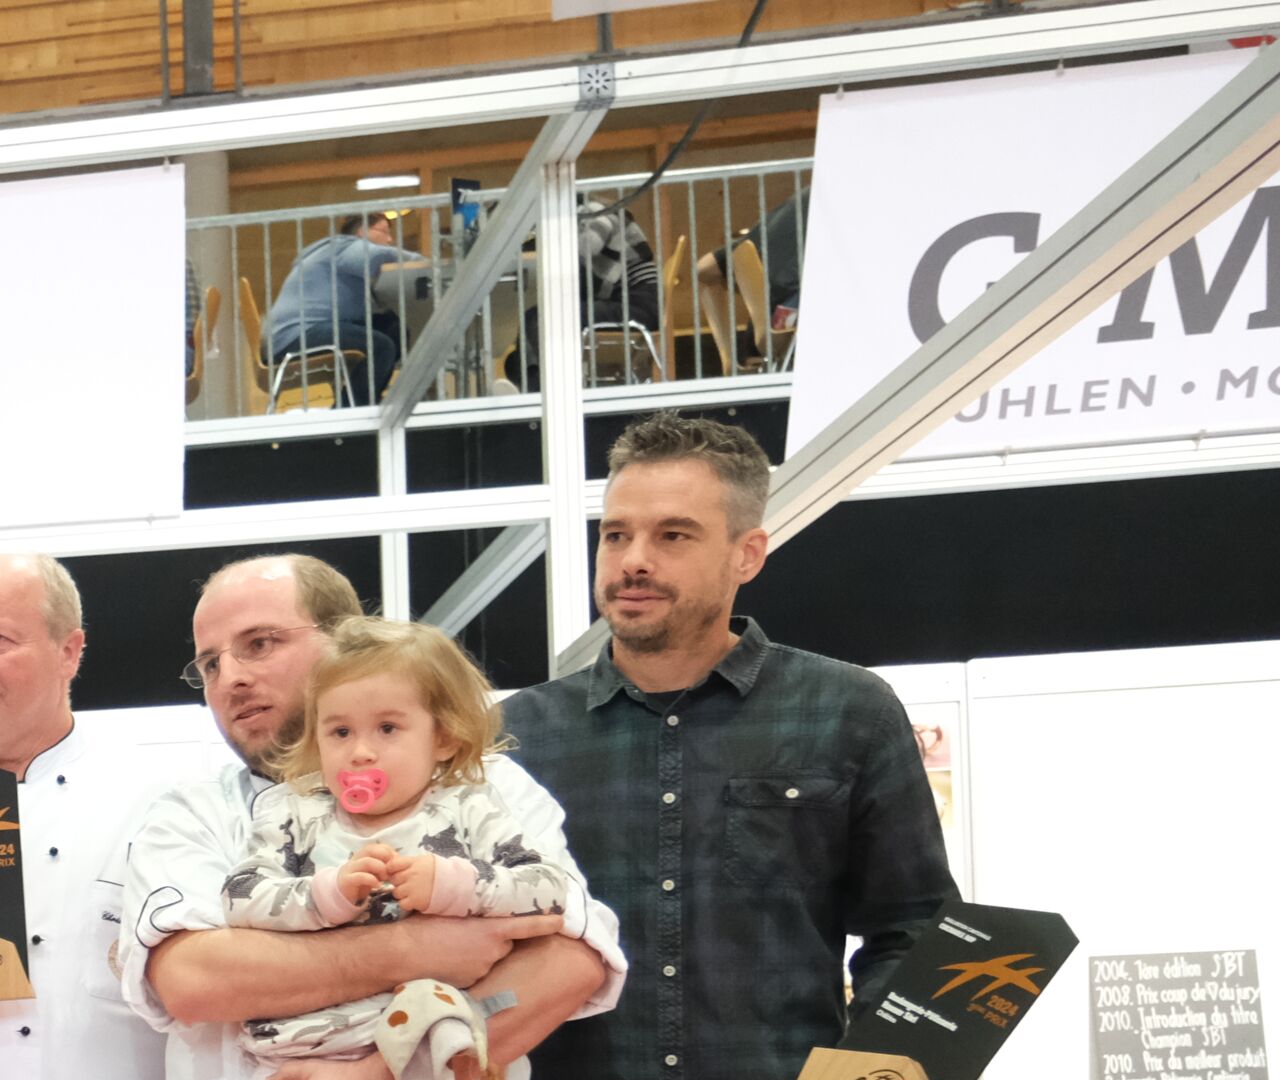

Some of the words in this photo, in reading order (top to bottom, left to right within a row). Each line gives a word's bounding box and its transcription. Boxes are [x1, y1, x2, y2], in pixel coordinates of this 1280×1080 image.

[954, 374, 1156, 422] HLEN
[1211, 952, 1246, 978] SBT
[987, 995, 1020, 1017] 2024
[1136, 984, 1159, 1005] Prix
[1160, 988, 1188, 1007] coup
[984, 1010, 1009, 1029] PRIX
[1201, 1026, 1227, 1047] SBT
